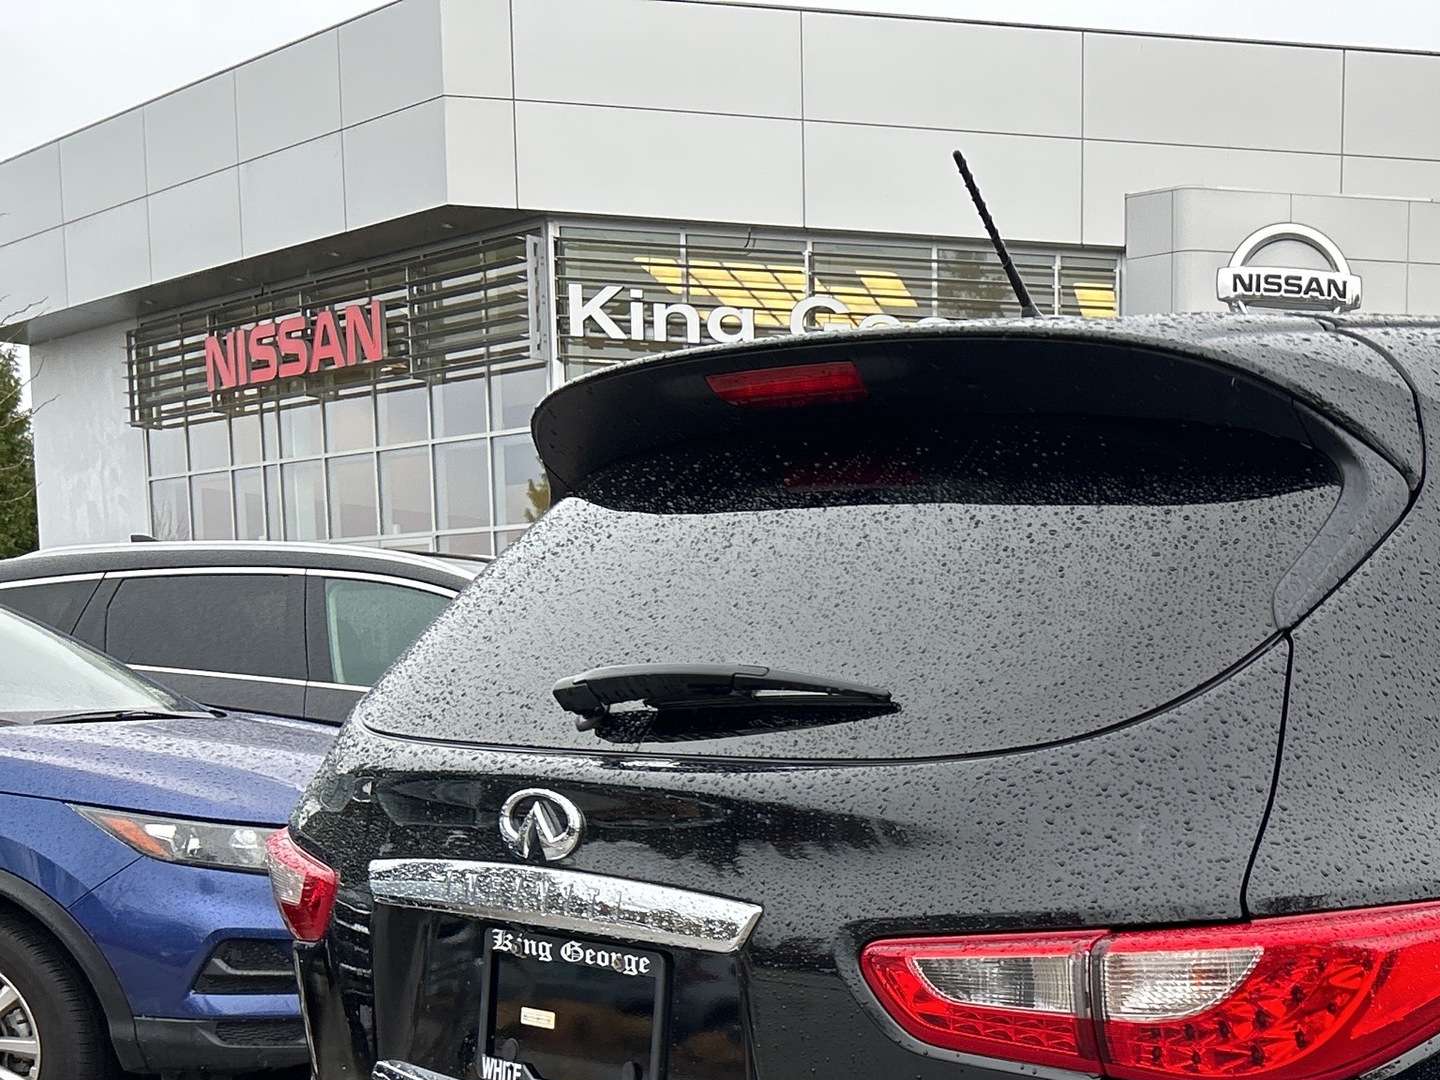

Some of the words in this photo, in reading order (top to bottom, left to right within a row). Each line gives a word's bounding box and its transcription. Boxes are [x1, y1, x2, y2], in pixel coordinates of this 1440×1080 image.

[1232, 273, 1347, 299] NISSAN
[568, 283, 754, 343] King
[205, 296, 384, 392] NISSAN
[560, 940, 651, 976] George
